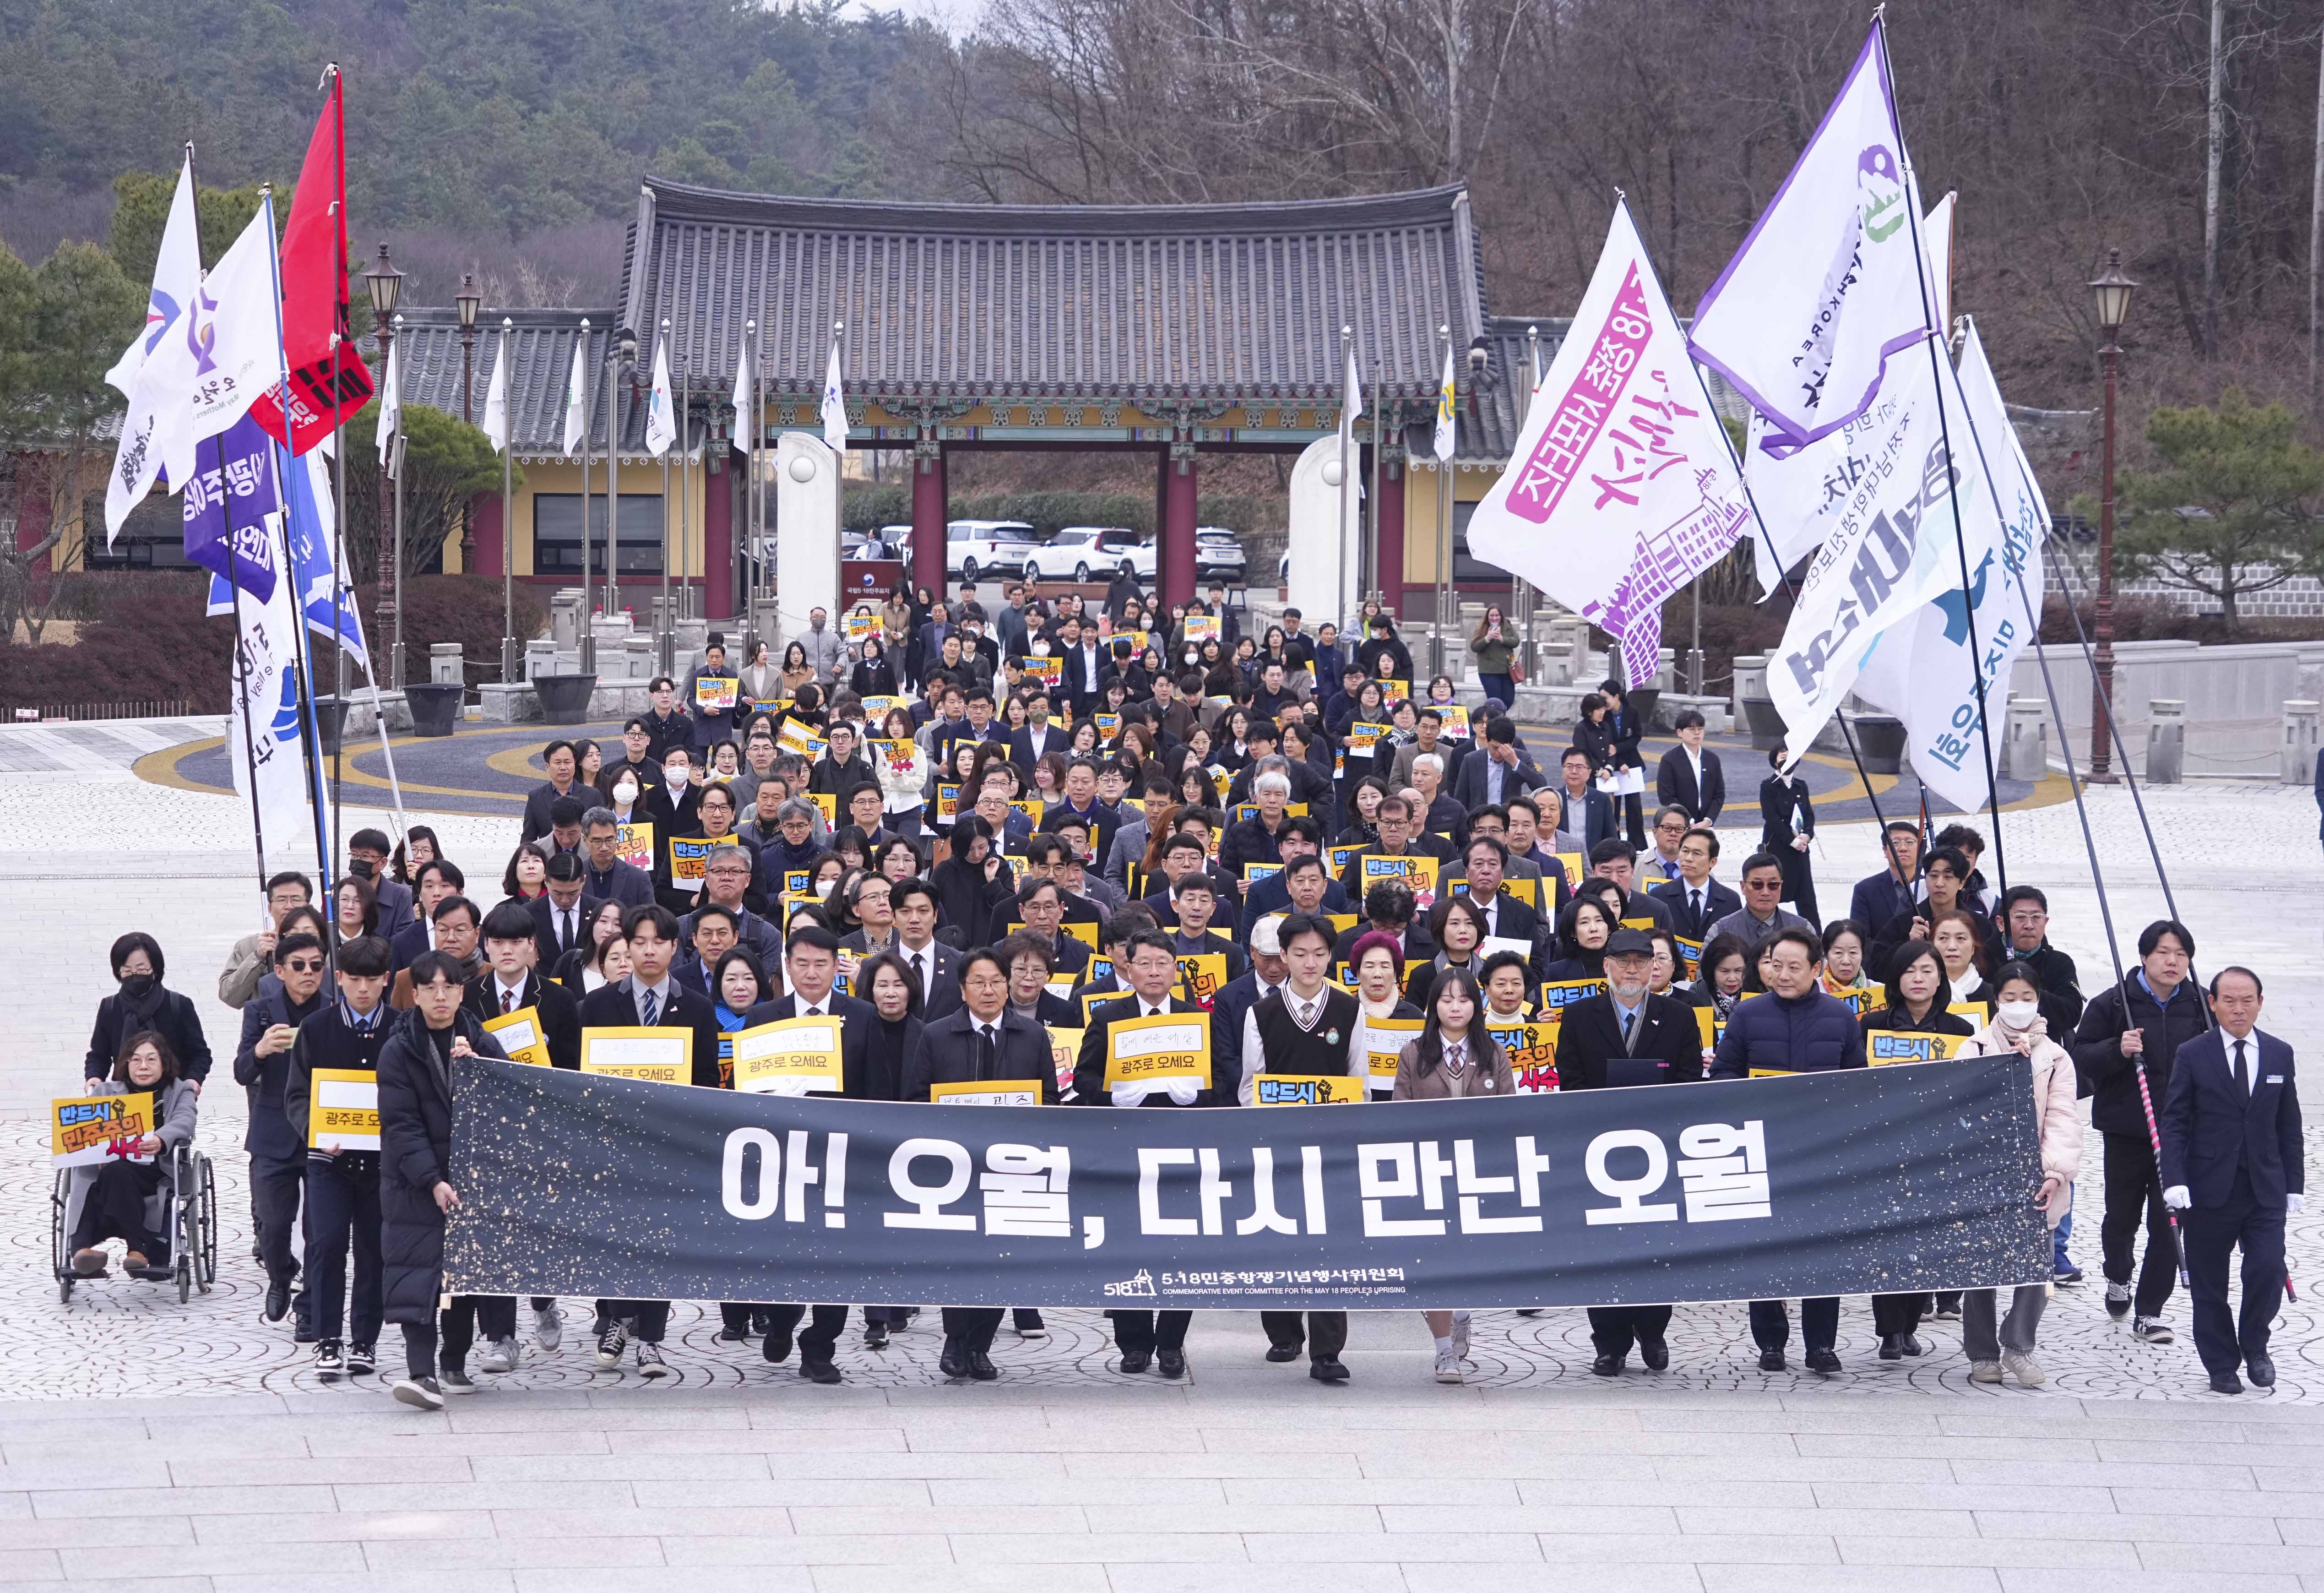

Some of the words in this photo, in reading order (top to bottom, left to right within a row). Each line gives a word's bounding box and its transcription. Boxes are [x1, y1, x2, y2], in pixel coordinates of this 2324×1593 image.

[700, 680, 721, 689] 반드시
[700, 686, 733, 701] 민주주의
[1355, 724, 1378, 736] 반드시
[1366, 859, 1406, 876] 반드시
[1873, 1035, 1930, 1061] 반드시
[749, 1055, 787, 1072] 광주로
[790, 1055, 827, 1068] 오세요
[1121, 1057, 1155, 1074] 광주로
[1157, 1055, 1195, 1069] 오세요
[638, 1068, 675, 1081] 오세요
[1519, 1066, 1560, 1093] 사수
[1259, 1078, 1316, 1104] 반드시
[59, 1101, 111, 1126] 반드시
[325, 1111, 365, 1126] 광주로
[62, 1113, 144, 1154] 민주주의
[722, 1127, 848, 1229] 아!
[883, 1138, 1105, 1250] 오월,
[1137, 1146, 1327, 1236] 다시
[1357, 1136, 1550, 1238] 만난
[1585, 1120, 1772, 1226] 오월
